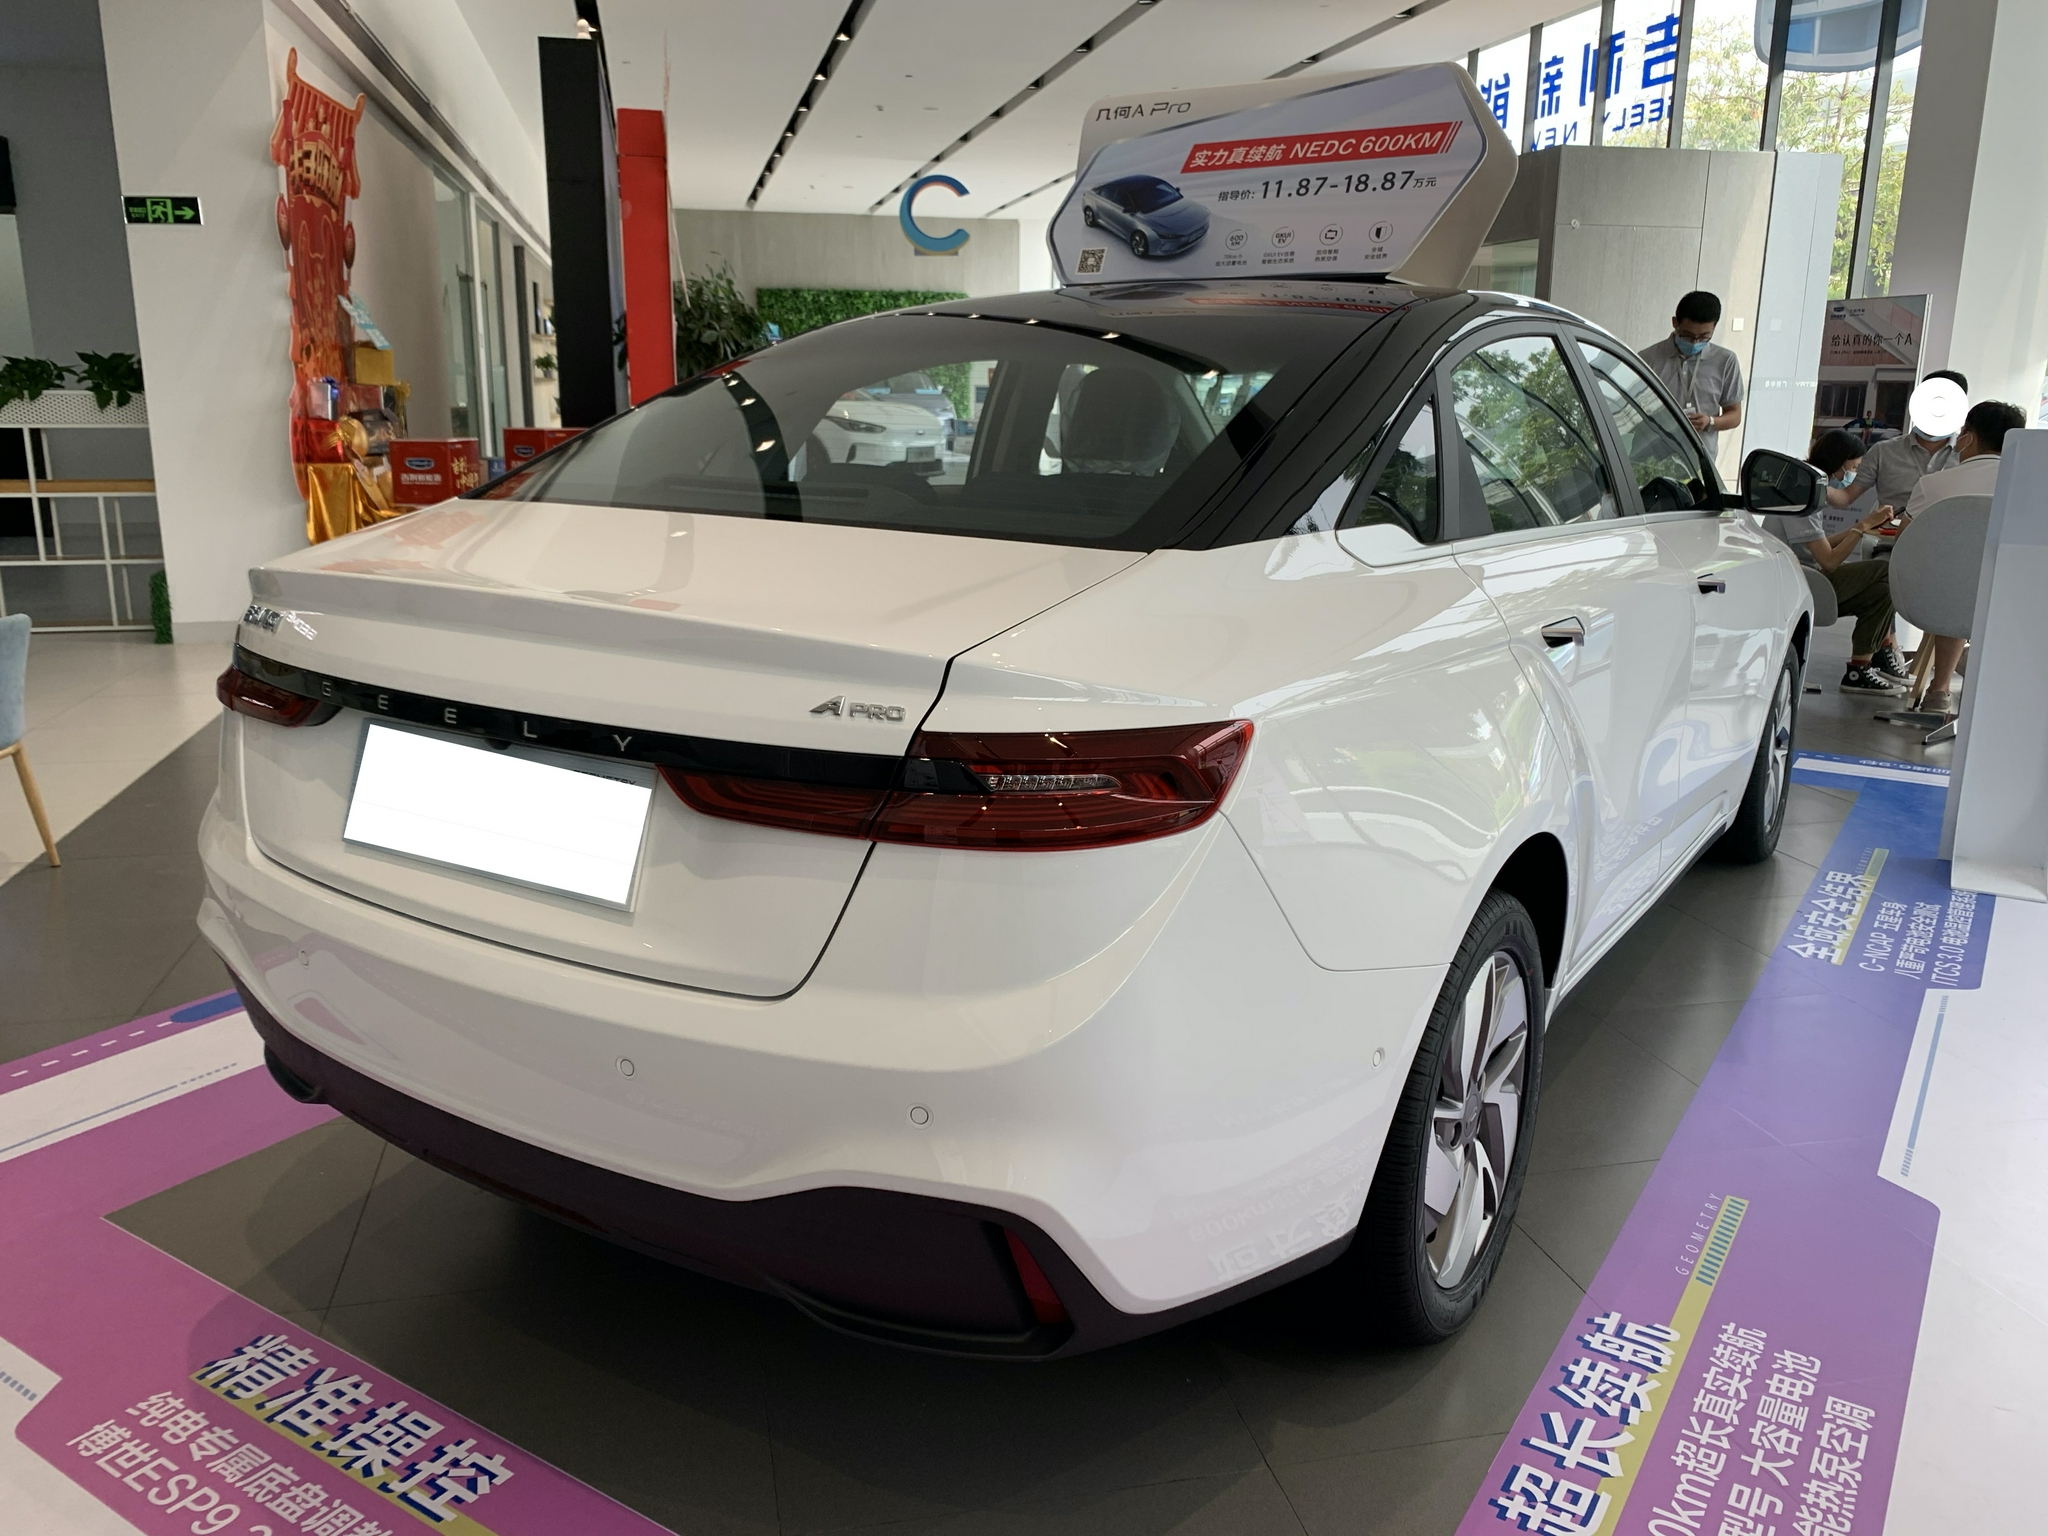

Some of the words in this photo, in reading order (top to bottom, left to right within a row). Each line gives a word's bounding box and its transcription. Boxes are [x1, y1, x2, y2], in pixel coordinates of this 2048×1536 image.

[1150, 102, 1191, 116] Pro
[1189, 144, 1287, 168] 实力真续航
[1289, 138, 1356, 160] NEDC
[1358, 131, 1443, 155] 600KM
[1229, 234, 1244, 242] 600
[1830, 333, 1913, 348] 给认真的你一个A
[321, 681, 633, 753] GEELY
[809, 695, 846, 717] A
[849, 702, 907, 722] PRO
[1786, 870, 1875, 964] 全域安全结界
[1873, 901, 1909, 932] 五星车身
[1858, 931, 1895, 972] C-NCAP
[1675, 1193, 1722, 1276] GEOMETRY
[196, 1333, 515, 1523] 精准操控
[1489, 1311, 1682, 1536] 超长续航
[1740, 1349, 1822, 1487] 大容量电池
